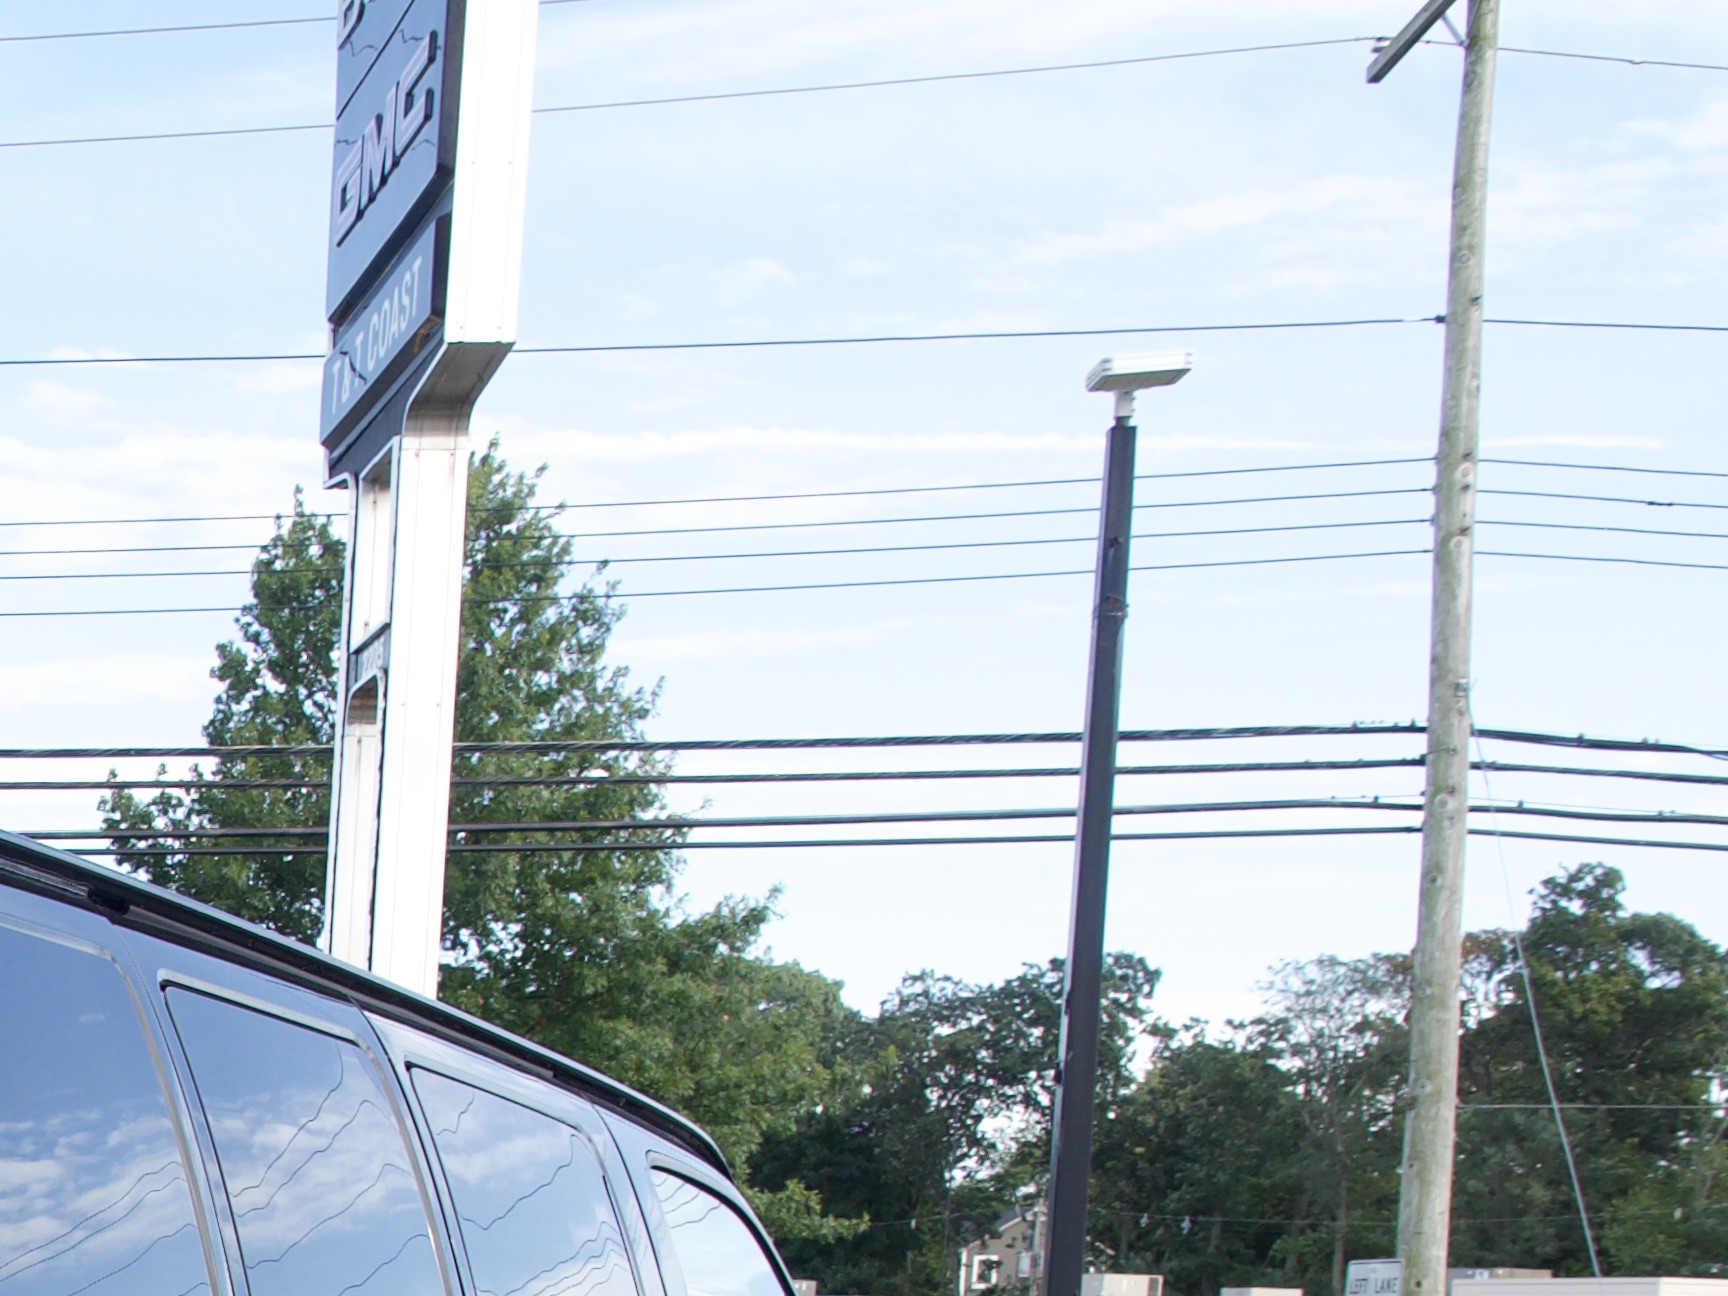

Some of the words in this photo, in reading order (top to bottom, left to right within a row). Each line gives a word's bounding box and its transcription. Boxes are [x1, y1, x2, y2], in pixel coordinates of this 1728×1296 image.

[334, 31, 438, 246] GMC
[367, 256, 423, 369] COAST
[1349, 1278, 1368, 1294] LEFT
[1374, 1277, 1398, 1294] LANE
